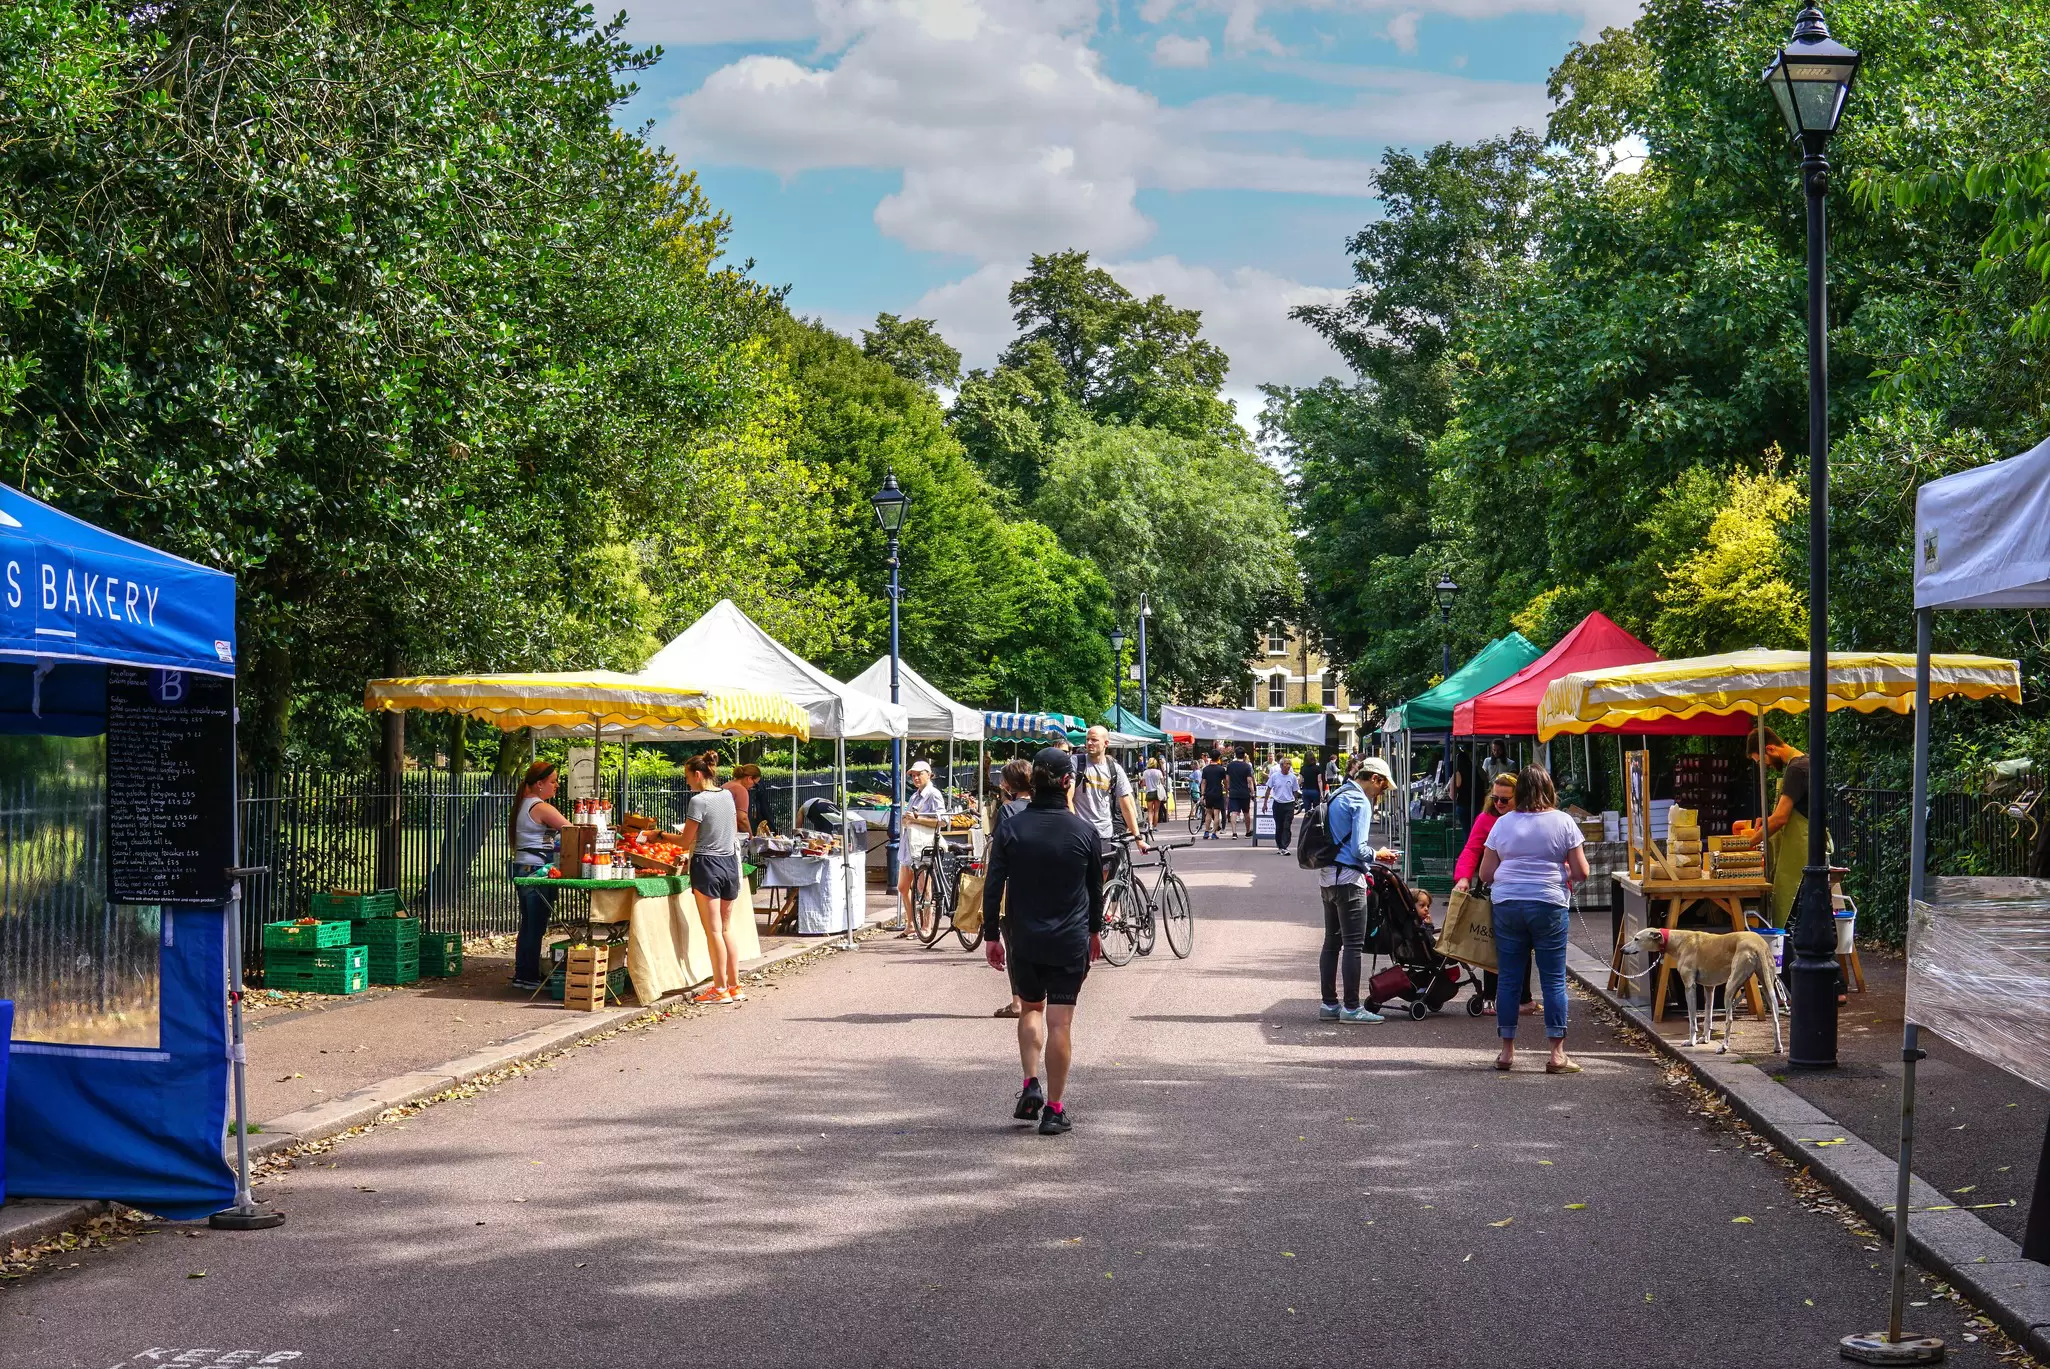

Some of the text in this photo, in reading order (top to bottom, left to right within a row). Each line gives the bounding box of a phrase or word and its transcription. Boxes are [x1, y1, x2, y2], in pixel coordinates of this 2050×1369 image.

[7, 561, 159, 627] S BAKERY
[157, 669, 182, 701] B
[1469, 922, 1494, 939] M&S
[132, 1347, 303, 1364] KEEP
